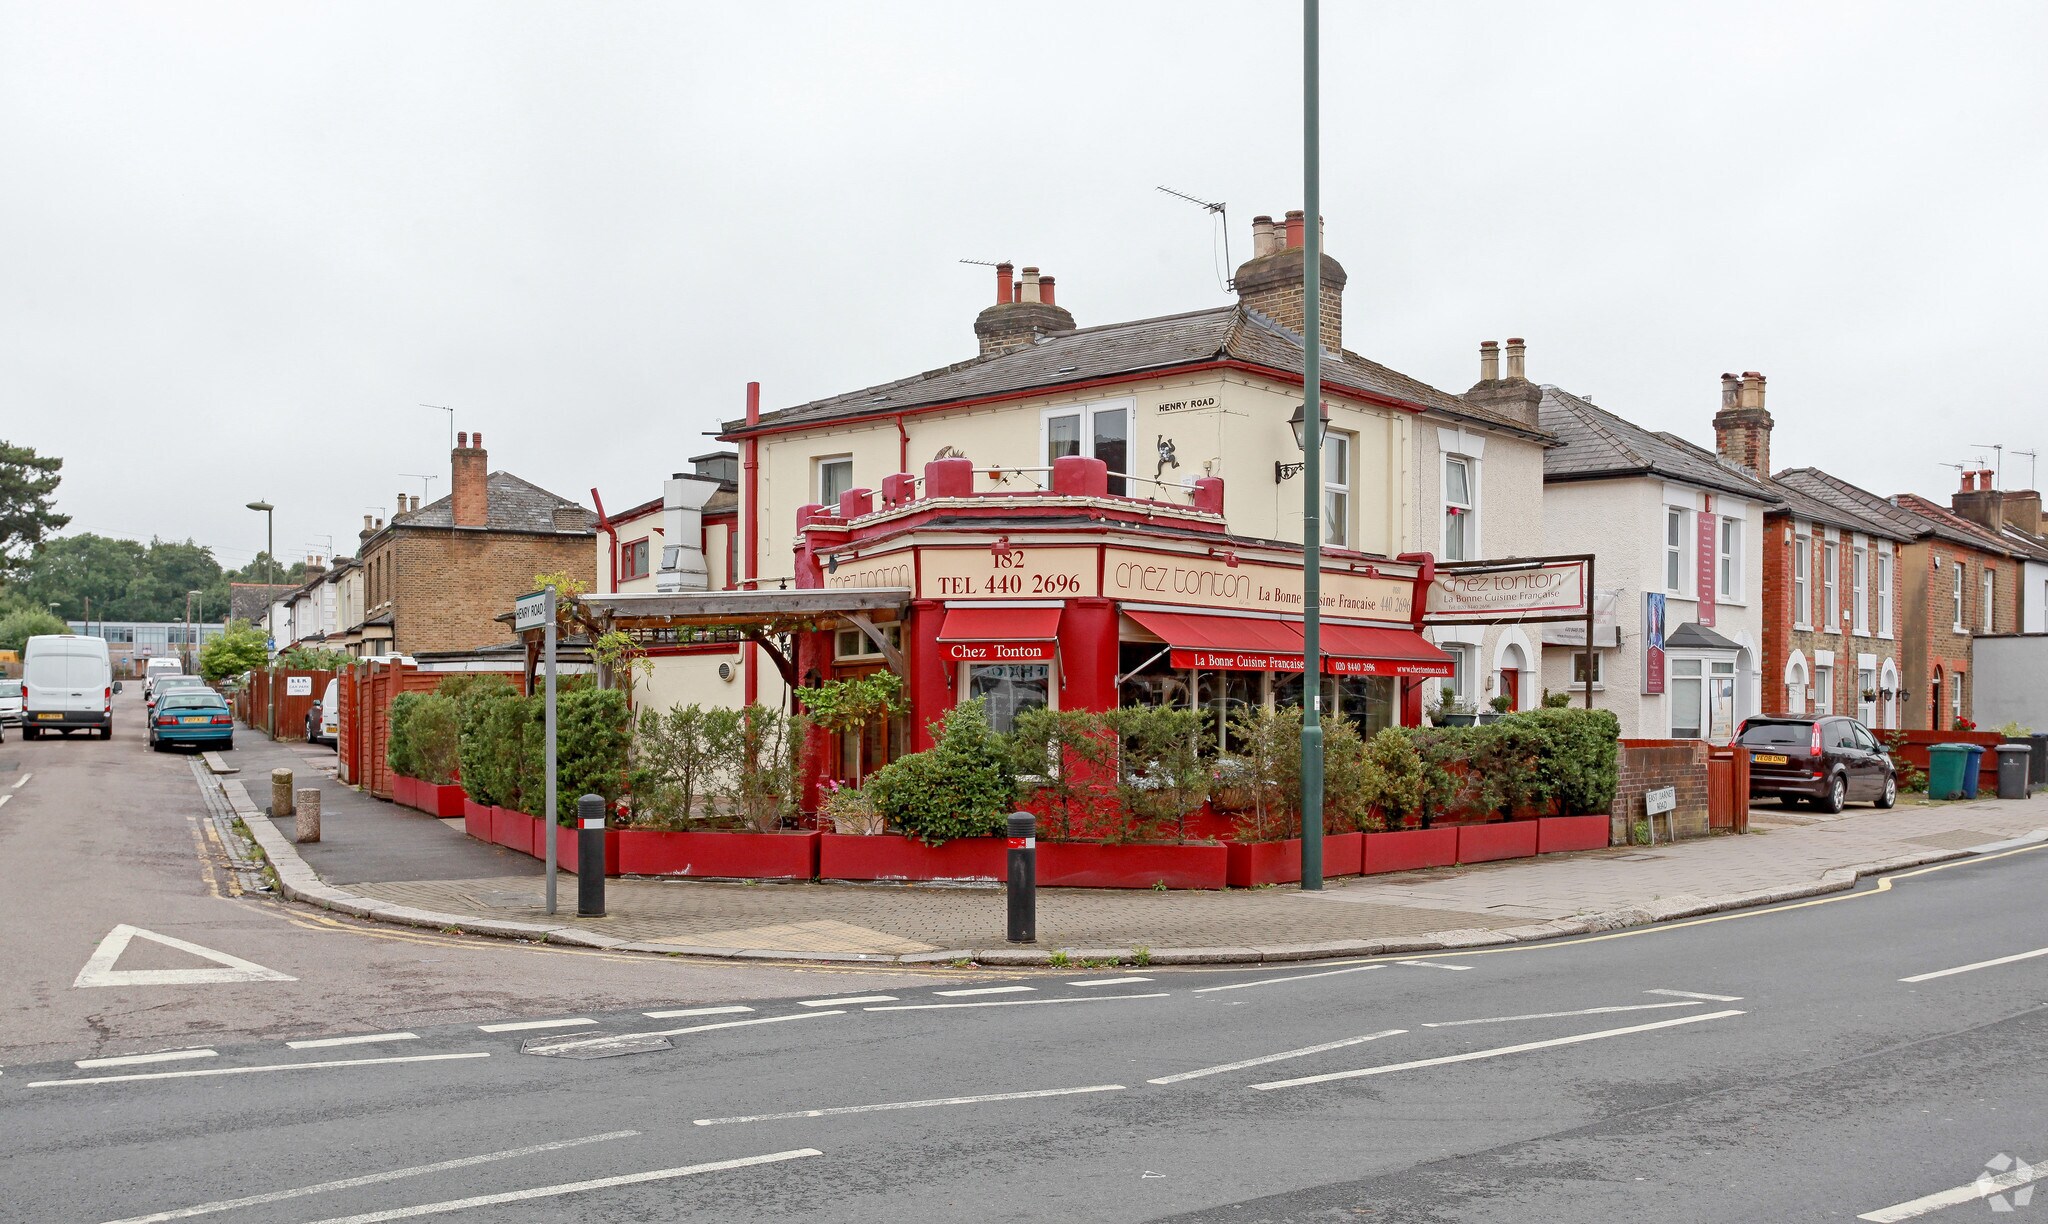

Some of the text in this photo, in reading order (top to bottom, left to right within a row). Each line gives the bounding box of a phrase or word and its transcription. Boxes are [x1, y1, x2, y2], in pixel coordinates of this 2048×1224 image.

[1159, 398, 1215, 412] HENRY ROAD
[993, 550, 1024, 568] 182
[938, 574, 1080, 594] TEL 440 2696
[1116, 562, 1250, 599] chez tonton
[1443, 572, 1562, 592] chez tonton
[1258, 586, 1271, 601] La
[1274, 588, 1302, 604] Bonne
[1338, 594, 1376, 612] Française
[1380, 596, 1411, 613] 440 2696
[1443, 590, 1560, 603] La Bonne Cuisine Française
[531, 602, 544, 617] ROAD
[951, 645, 1042, 658] Chez Tonton
[1194, 654, 1304, 670] La Bonne Cuisine Française
[1335, 662, 1375, 672] 020 8440 2696
[1397, 665, 1448, 674] www.cheztonton.co.uk
